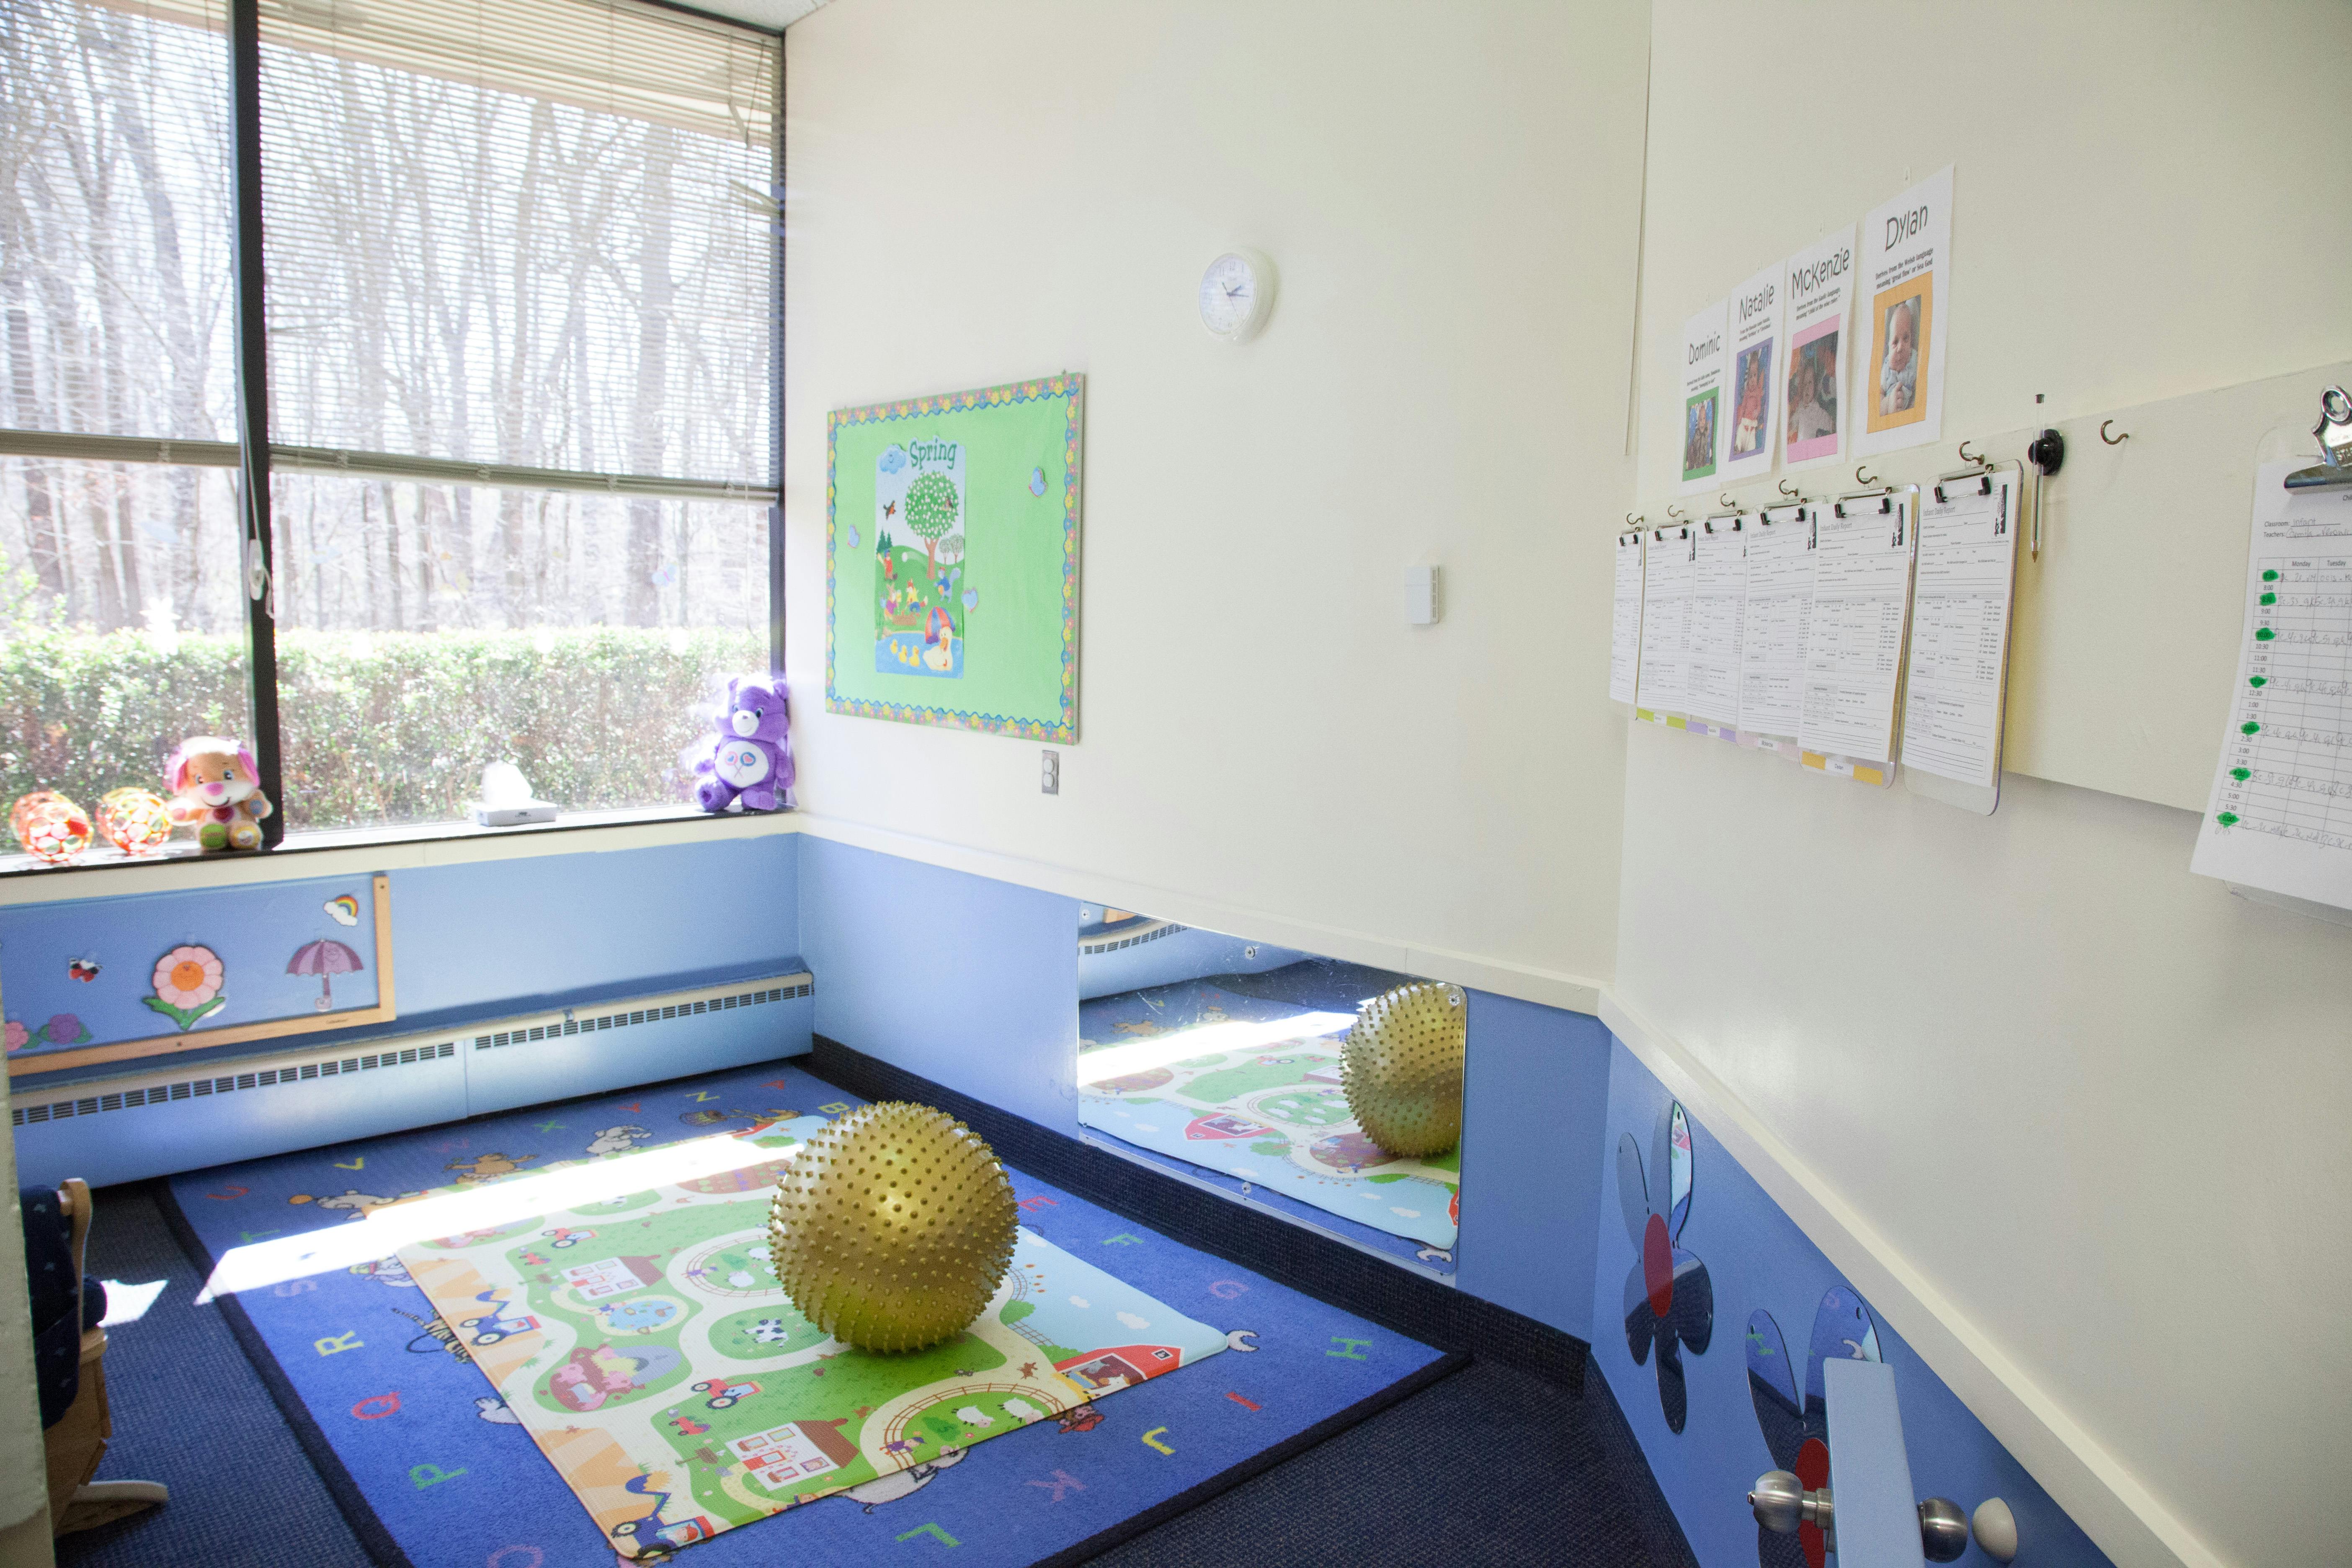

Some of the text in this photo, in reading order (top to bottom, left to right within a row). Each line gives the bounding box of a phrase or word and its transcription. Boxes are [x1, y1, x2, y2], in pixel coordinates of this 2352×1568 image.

[1885, 205, 1928, 251] Dylan
[1792, 247, 1849, 299] McKenzie
[1739, 284, 1774, 324] Natalie
[1689, 331, 1720, 365] Dominic
[910, 438, 957, 470] Spring
[1923, 507, 1934, 516] Infant
[1934, 507, 1943, 516] Daily
[685, 1091, 720, 1102] Z
[818, 1102, 850, 1113] B
[335, 1157, 364, 1170] V
[1018, 1196, 1058, 1212] E
[1102, 1232, 1144, 1246] F
[274, 1280, 317, 1297] S
[1209, 1279, 1248, 1299] G
[314, 1330, 364, 1357] R
[1325, 1336, 1373, 1361] H
[351, 1391, 401, 1420] Q
[408, 1463, 468, 1490] P
[1026, 1469, 1087, 1503] K
[895, 1522, 962, 1549] L
